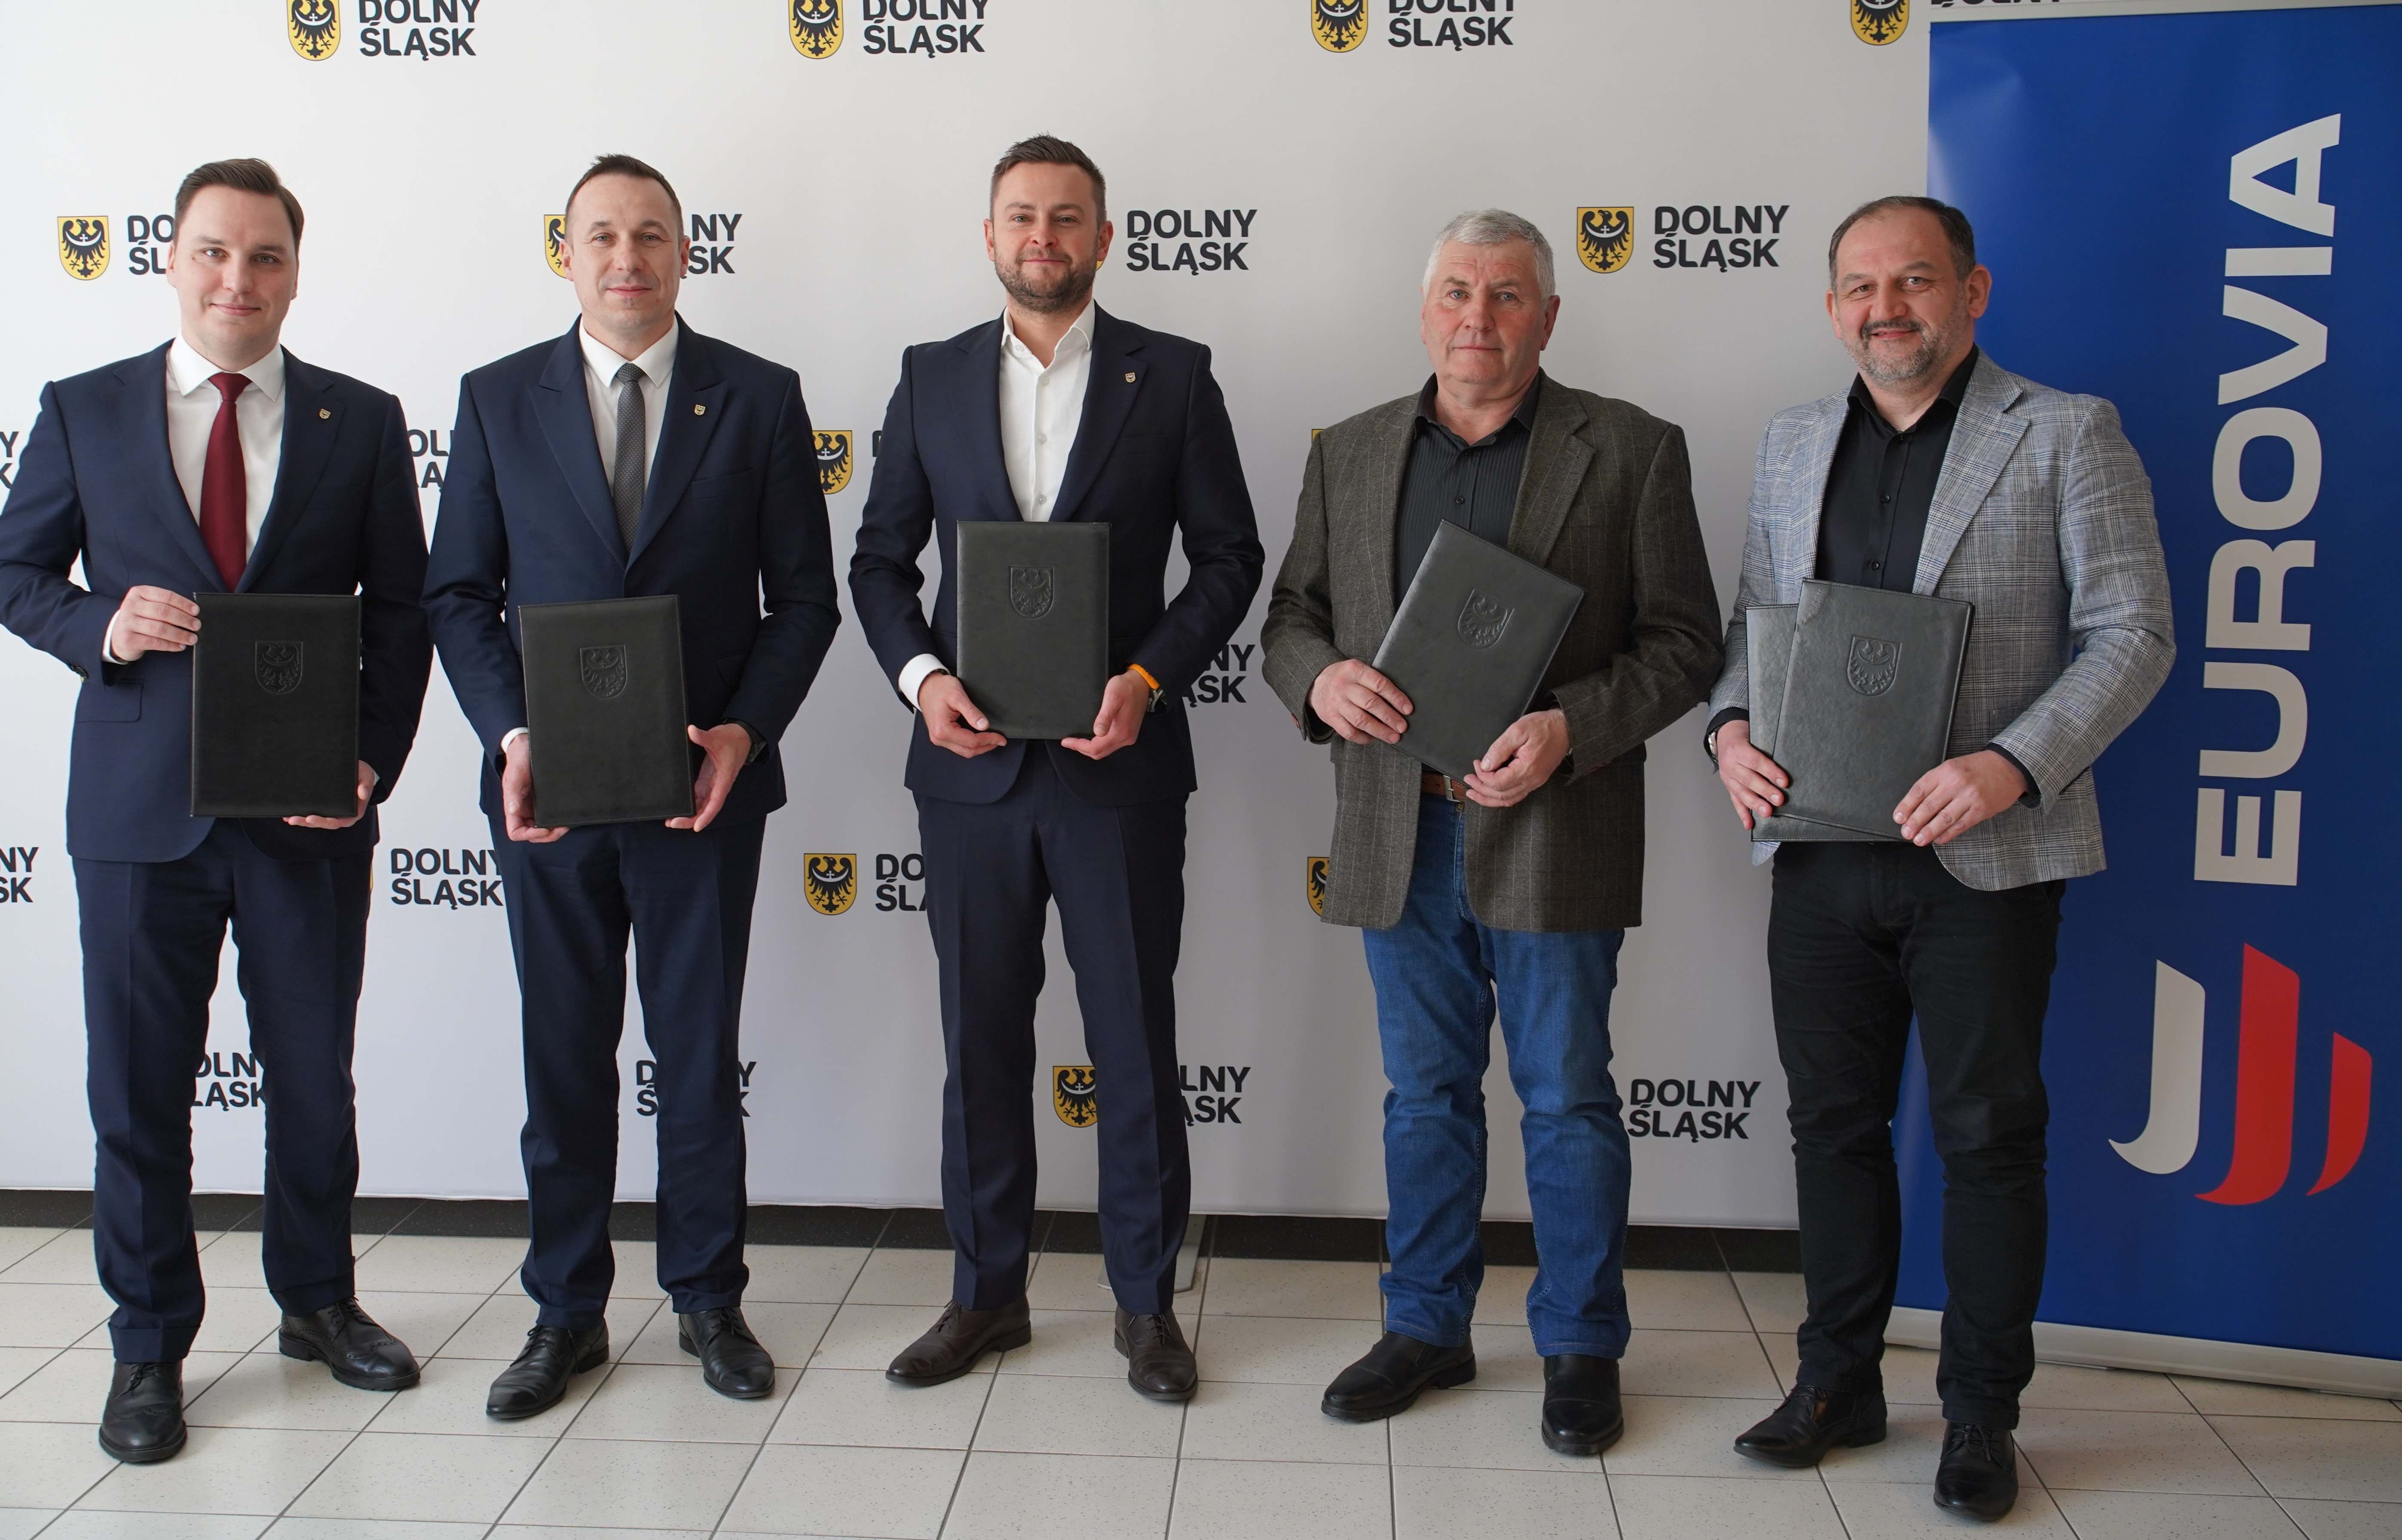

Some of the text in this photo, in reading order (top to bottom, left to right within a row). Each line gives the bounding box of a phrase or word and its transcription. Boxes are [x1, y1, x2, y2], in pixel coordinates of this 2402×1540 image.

[359, 0, 480, 24] DOLNY
[863, 0, 988, 21] DOLNY
[360, 22, 477, 61] ŚLĄSK
[863, 19, 985, 58] ŚLĄSK
[1388, 12, 1514, 52] ŚLĄSK
[1127, 209, 1258, 239] DOLNY
[1655, 205, 1790, 235] DOLNY
[1126, 236, 1249, 276] ŚLĄSK
[1653, 233, 1780, 273] ŚLĄSK
[2194, 113, 2341, 887] EUROVIA
[391, 873, 504, 910] ŚLĄSK
[1180, 1065, 1251, 1093] LNY
[1630, 1078, 1762, 1108] DOLNY
[1627, 1104, 1751, 1143] ŚLĄSK
